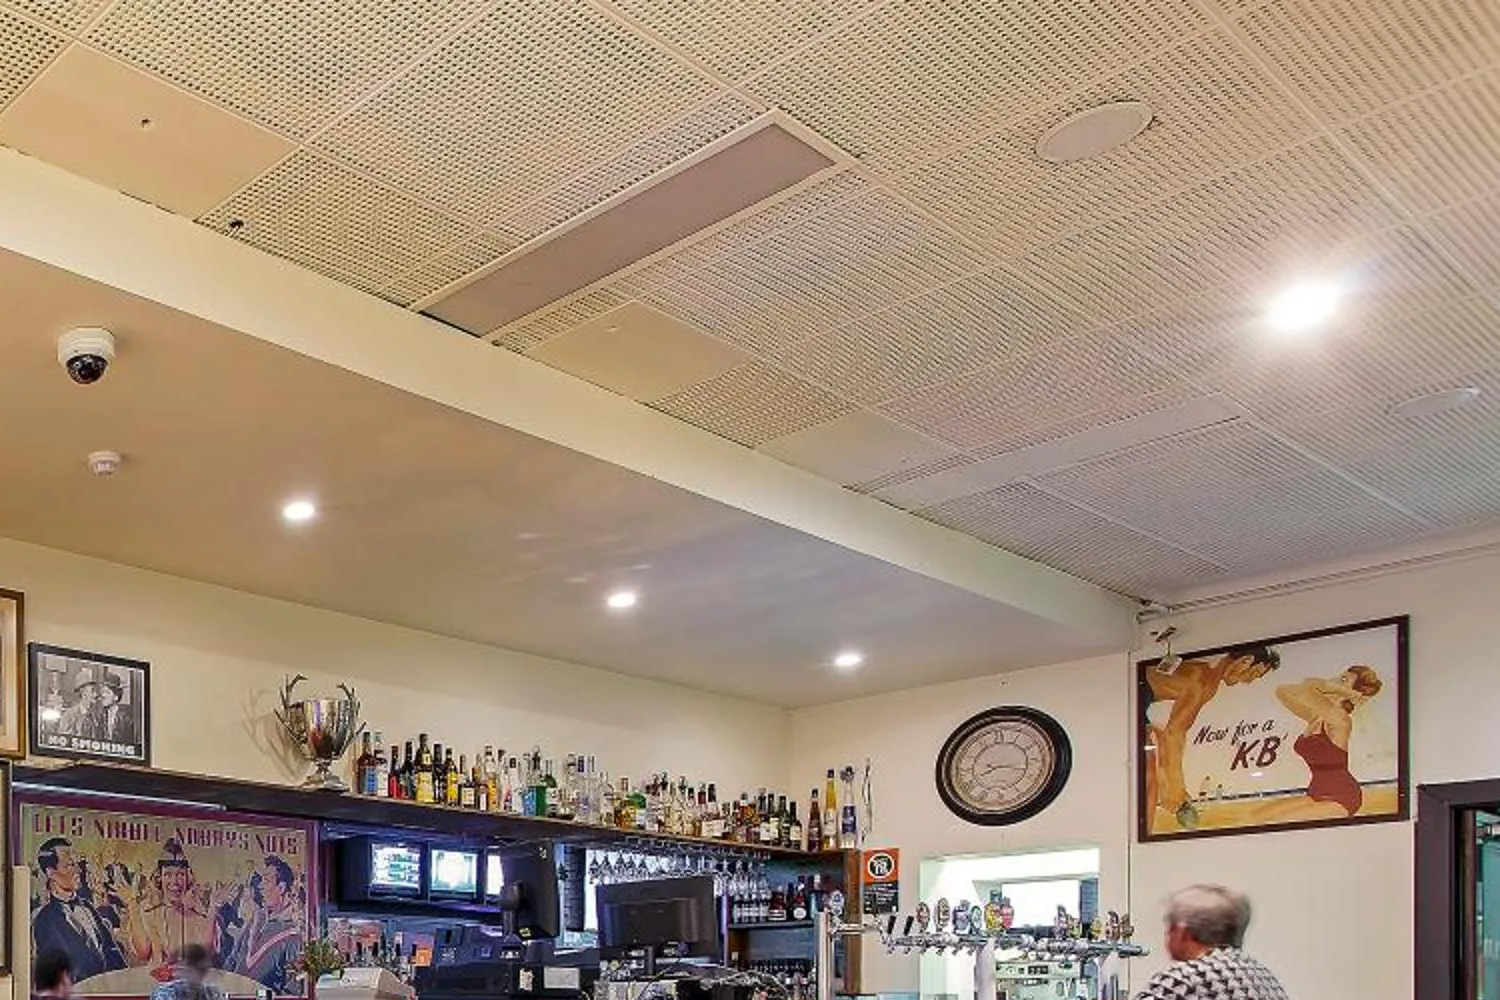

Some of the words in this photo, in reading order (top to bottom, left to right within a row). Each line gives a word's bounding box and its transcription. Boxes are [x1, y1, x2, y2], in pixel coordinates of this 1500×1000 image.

[1192, 725, 1229, 745] Now
[1231, 719, 1259, 746] for
[1261, 719, 1275, 732] a
[47, 735, 68, 747] NO
[71, 737, 136, 755] SMOKING
